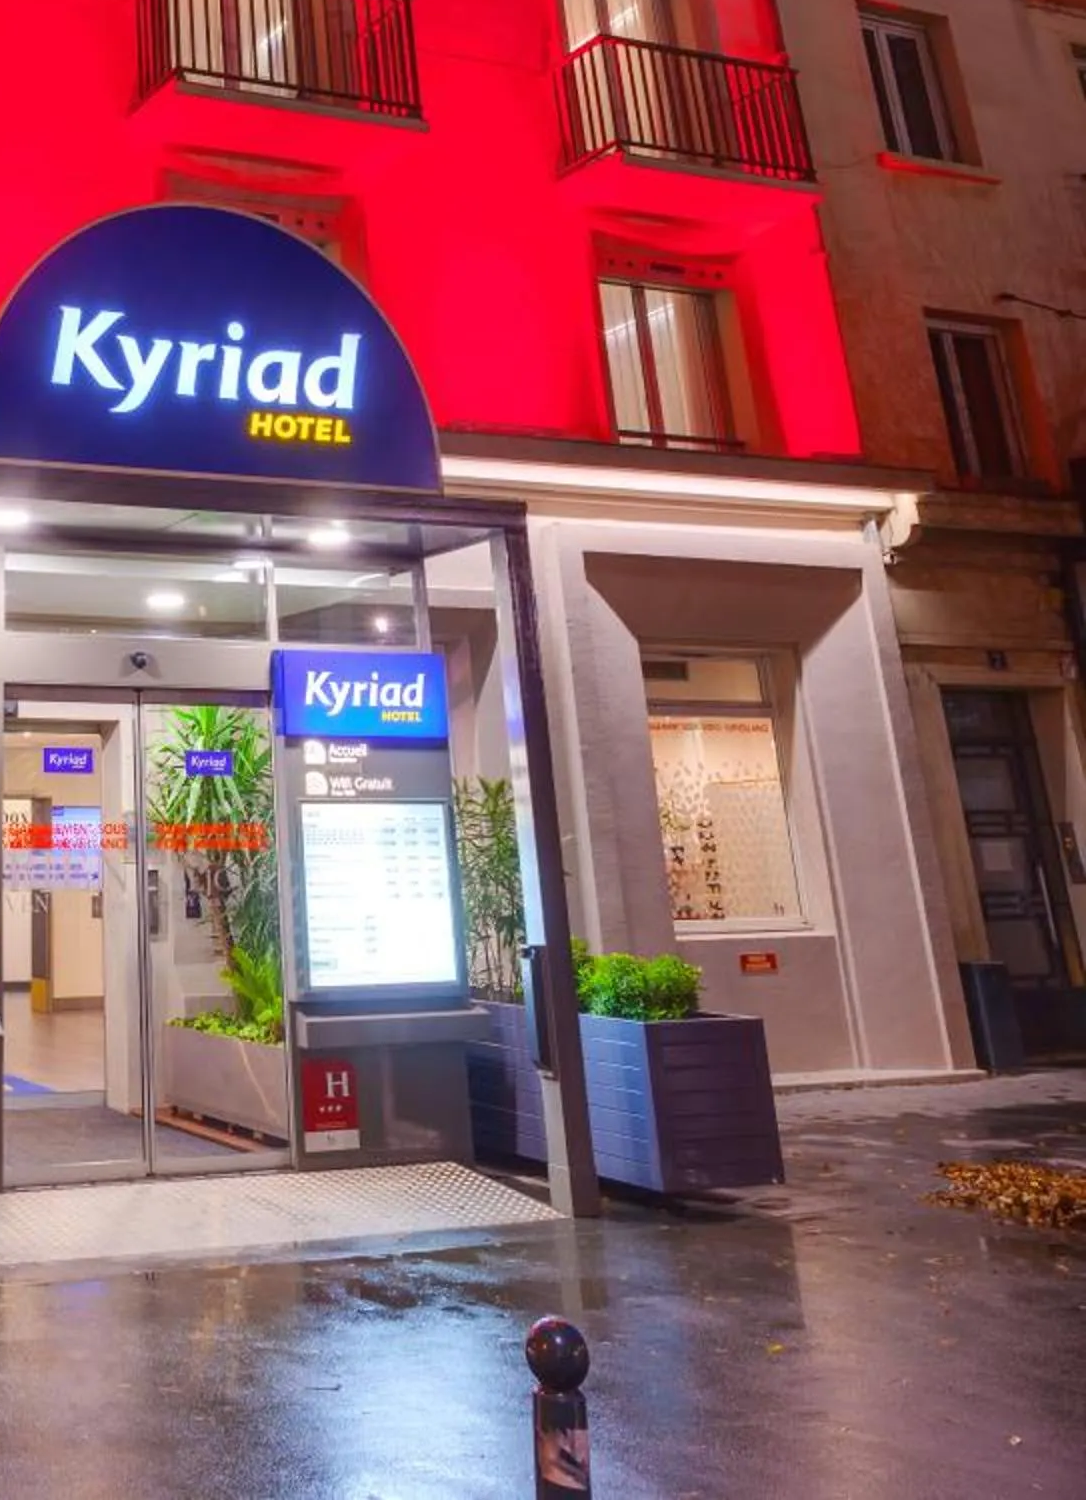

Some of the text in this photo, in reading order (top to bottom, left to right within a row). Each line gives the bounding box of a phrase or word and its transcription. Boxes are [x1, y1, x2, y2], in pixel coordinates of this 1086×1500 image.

[50, 305, 363, 414] Kyriad
[248, 411, 352, 445] HOTEL
[304, 670, 426, 718] Kyriad
[381, 710, 423, 723] HOTEL
[49, 752, 87, 767] Kyriad
[190, 755, 228, 771] Kyriad
[325, 1070, 350, 1098] H
